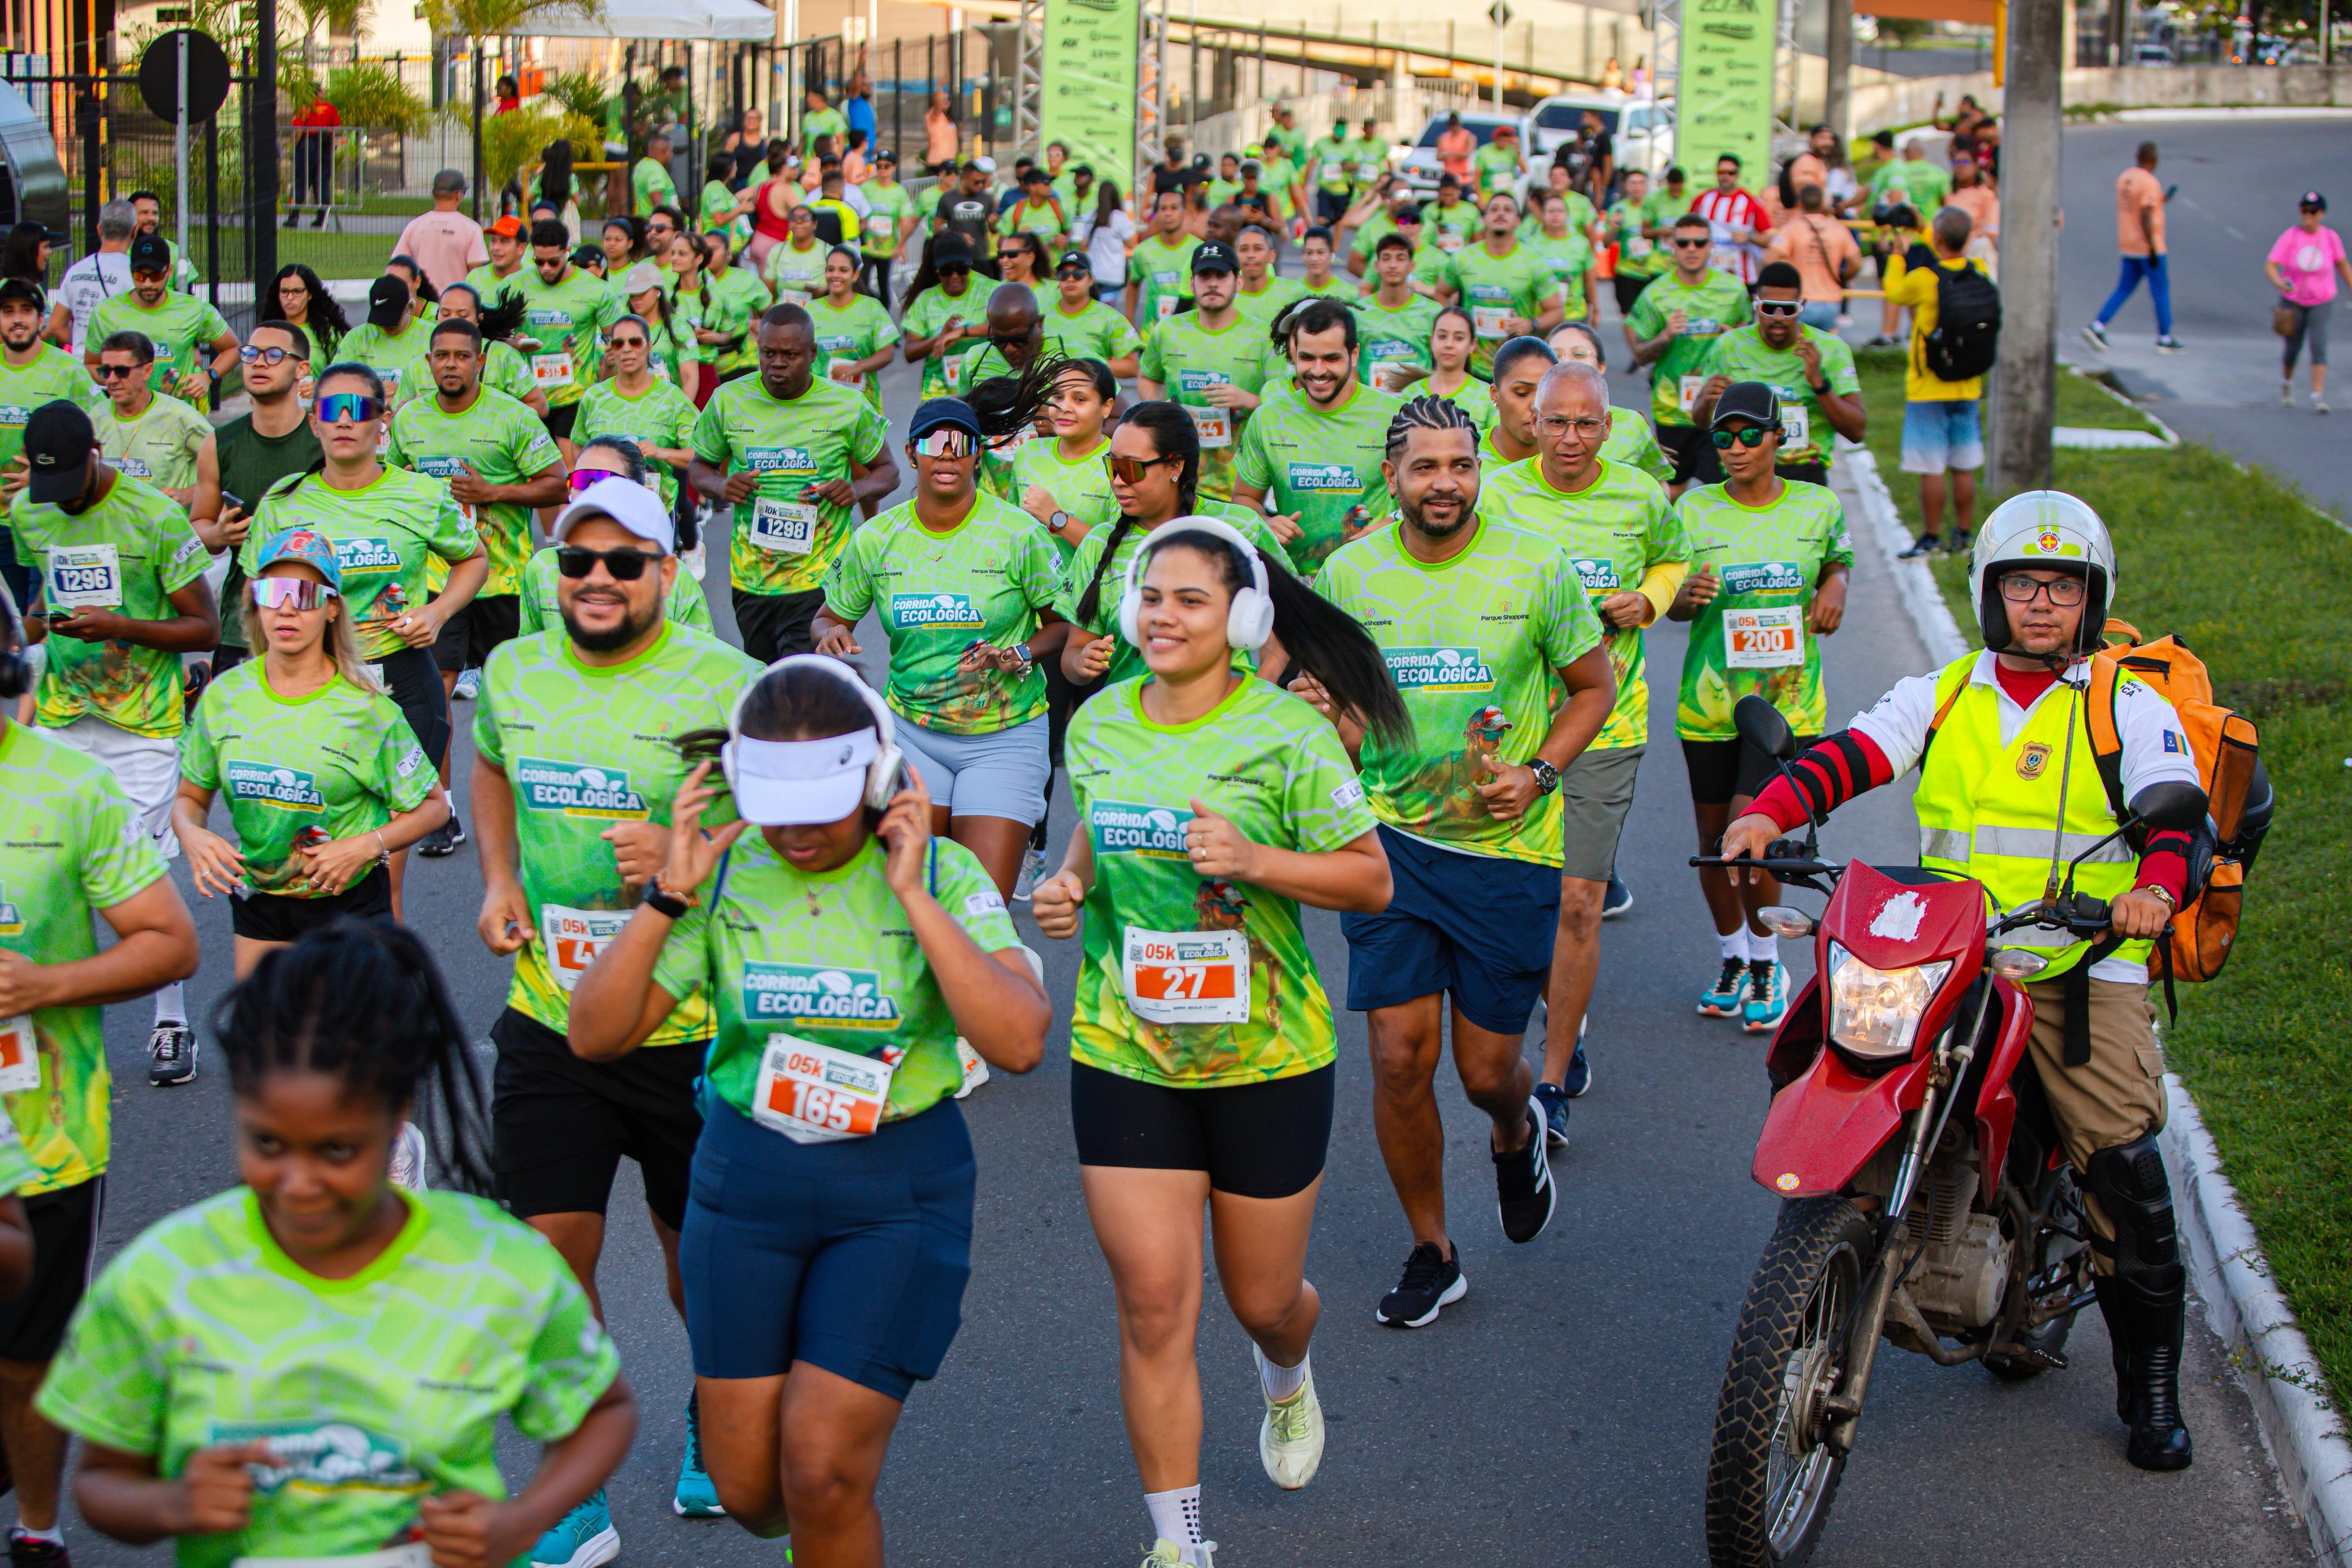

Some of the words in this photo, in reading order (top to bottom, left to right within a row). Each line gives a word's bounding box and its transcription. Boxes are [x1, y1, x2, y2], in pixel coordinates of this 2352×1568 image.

[754, 458, 815, 469] ECOLÓGICA
[1291, 468, 1328, 477] CORRIDA
[1298, 475, 1360, 488] ECOLÓGICA
[765, 505, 778, 516] 10k
[767, 518, 805, 539] 1298
[339, 552, 397, 567] OLÓGICA
[60, 568, 110, 592] 1296
[1580, 573, 1618, 588] ÓGICA
[1726, 569, 1767, 581] CORRIDA
[1736, 575, 1803, 591] ECOLÓGICA
[893, 600, 936, 610] CORRIDA
[901, 607, 979, 623] ECOLÓGICA
[1738, 616, 1758, 627] 05k
[1741, 630, 1785, 652] 200
[1386, 654, 1439, 668] CORRIDA
[1398, 664, 1489, 683] ECOLÓGICA
[230, 769, 276, 783] CORRIDA
[520, 769, 583, 787] CORRIDA
[1208, 773, 1232, 782] Parque
[1233, 774, 1266, 787] Shopping
[236, 781, 321, 805] ECOLÓGICA
[534, 785, 641, 809] ECOLÓGICA
[1093, 811, 1151, 829] CORRIDA
[562, 917, 589, 935] 05k
[1145, 942, 1177, 960] 05k
[745, 973, 820, 993] CORRIDA
[1162, 966, 1207, 1000] 27
[756, 991, 892, 1018] ECOLÓGICA
[788, 1052, 825, 1078] 05k
[793, 1081, 857, 1131] 165
